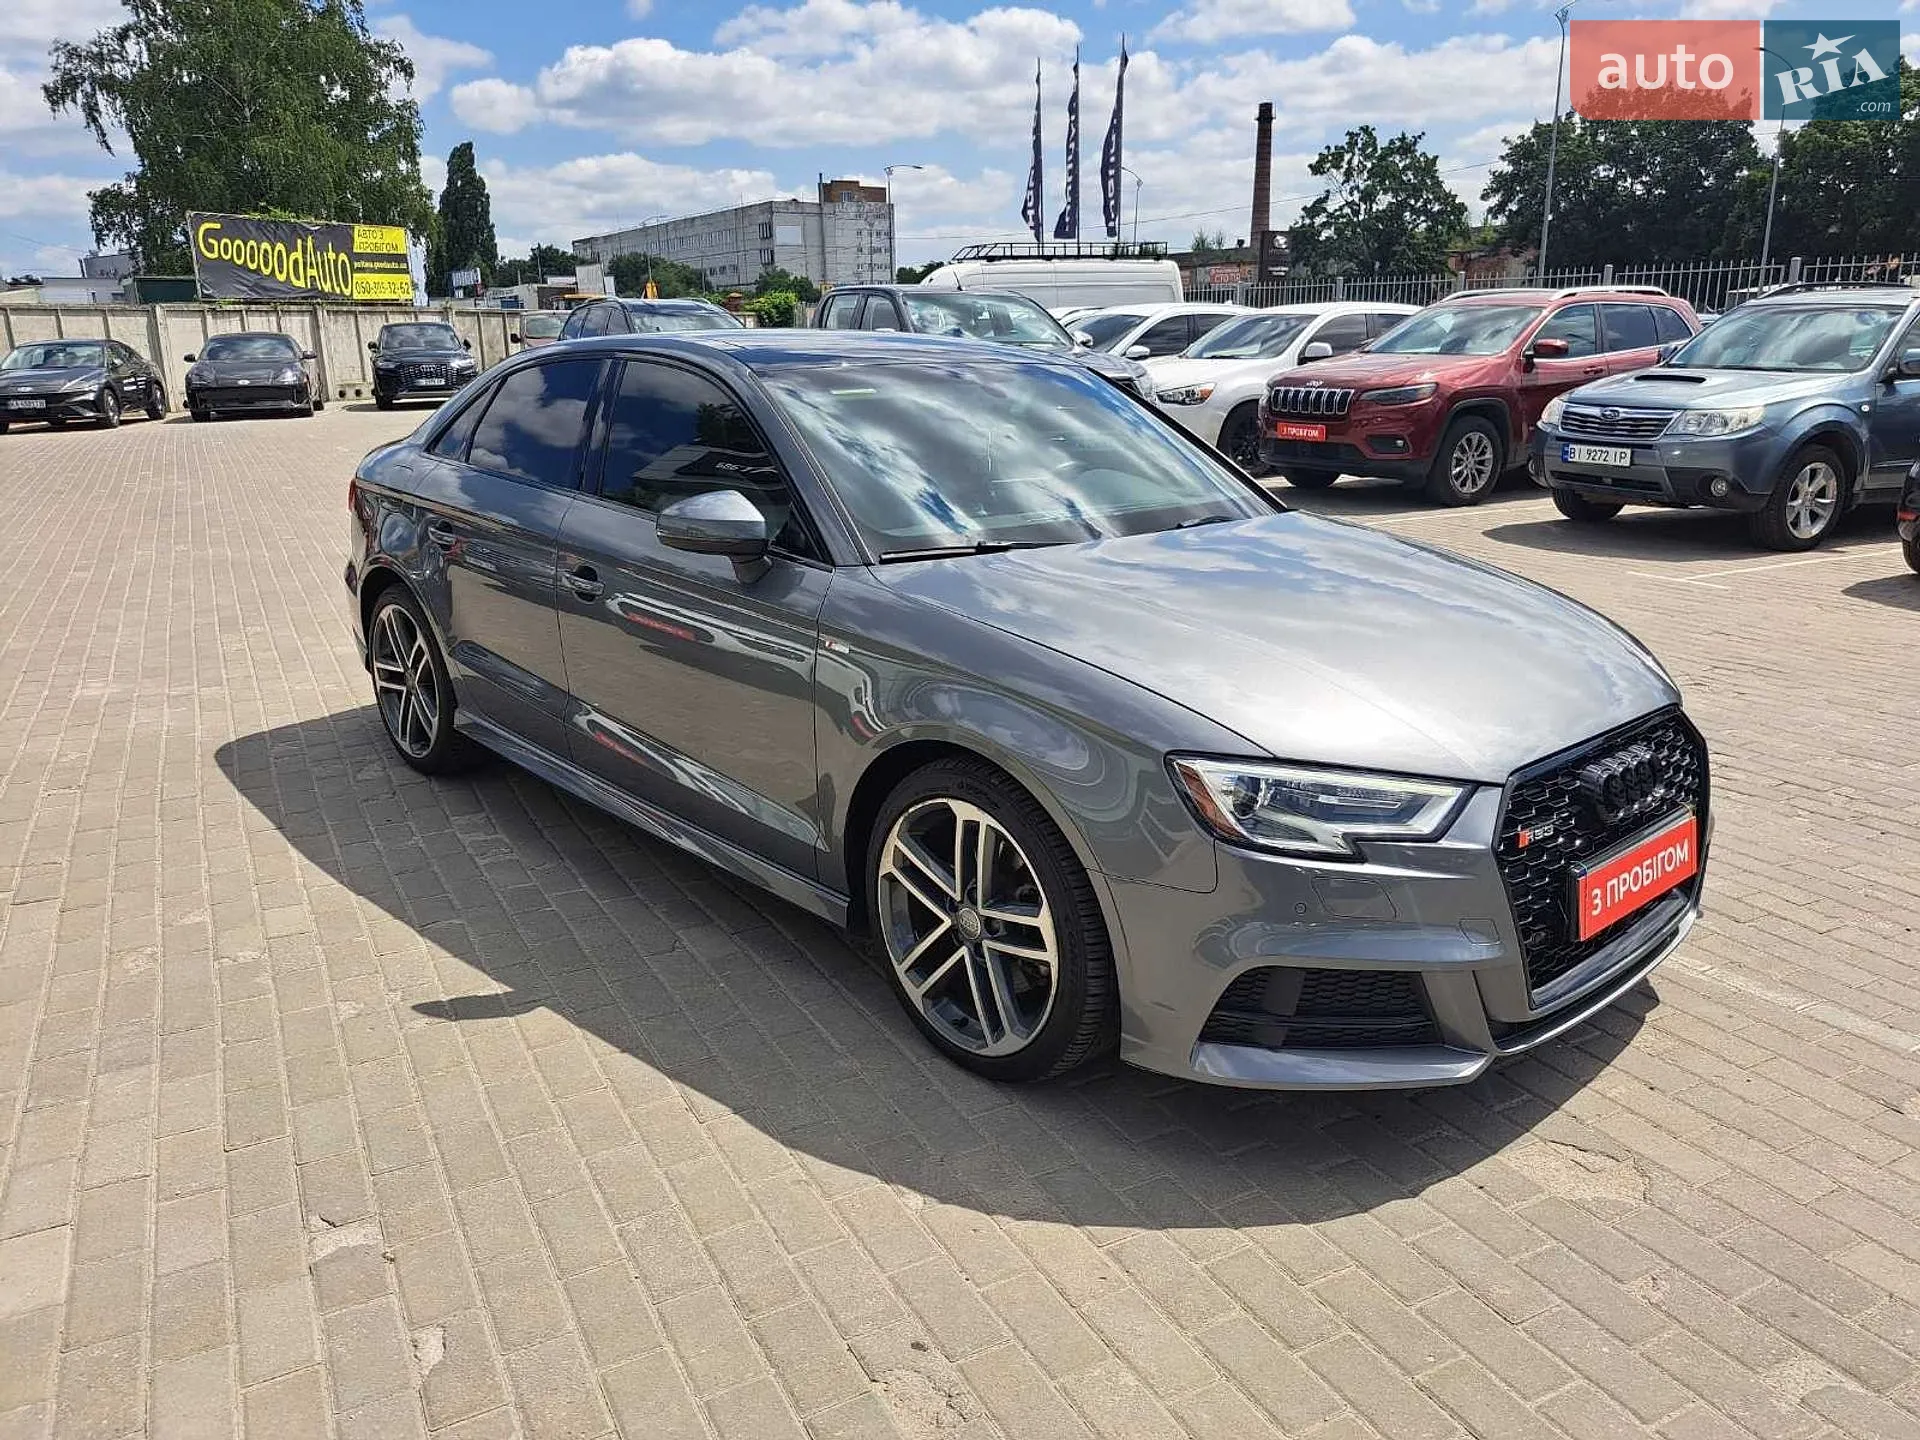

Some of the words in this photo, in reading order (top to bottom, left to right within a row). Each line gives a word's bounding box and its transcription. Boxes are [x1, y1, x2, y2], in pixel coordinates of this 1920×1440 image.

[357, 229, 377, 240] АВТО
[1586, 448, 1609, 462] 9272
[1591, 888, 1602, 916] З
[1606, 838, 1689, 908] ПРОБІГОМ
